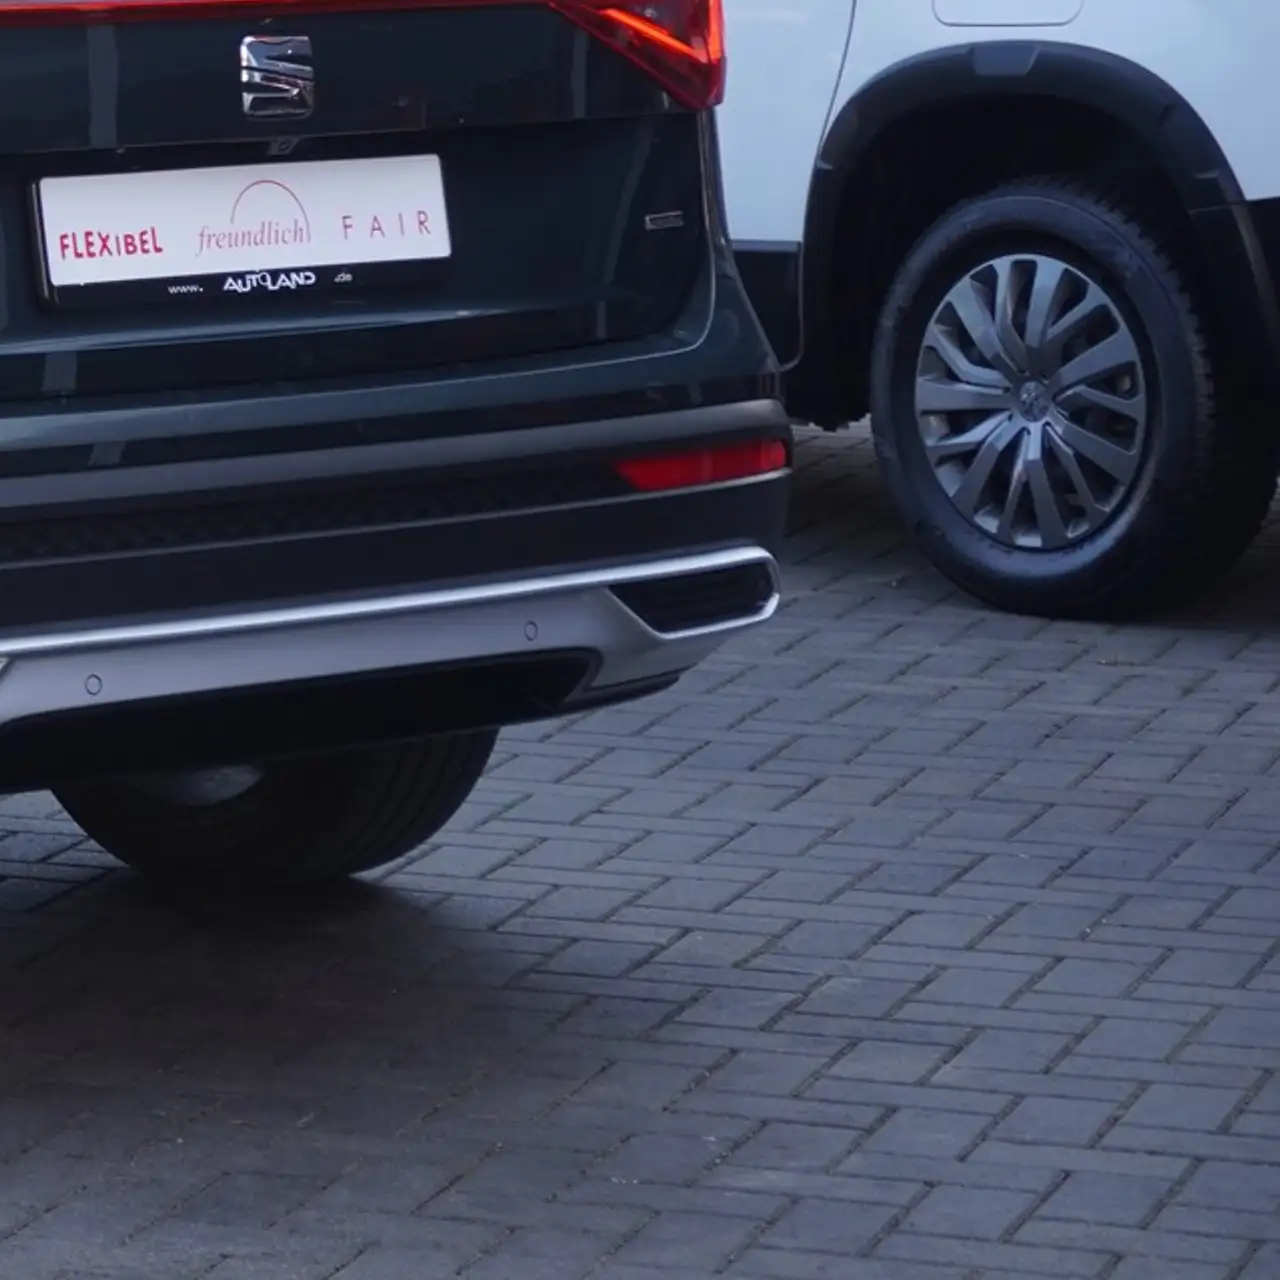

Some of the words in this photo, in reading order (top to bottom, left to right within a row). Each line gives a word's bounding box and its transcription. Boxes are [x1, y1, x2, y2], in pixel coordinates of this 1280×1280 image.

[59, 226, 164, 261] FLEXIBEL
[196, 217, 306, 257] freundlich
[223, 269, 316, 293] AUTOLAND
